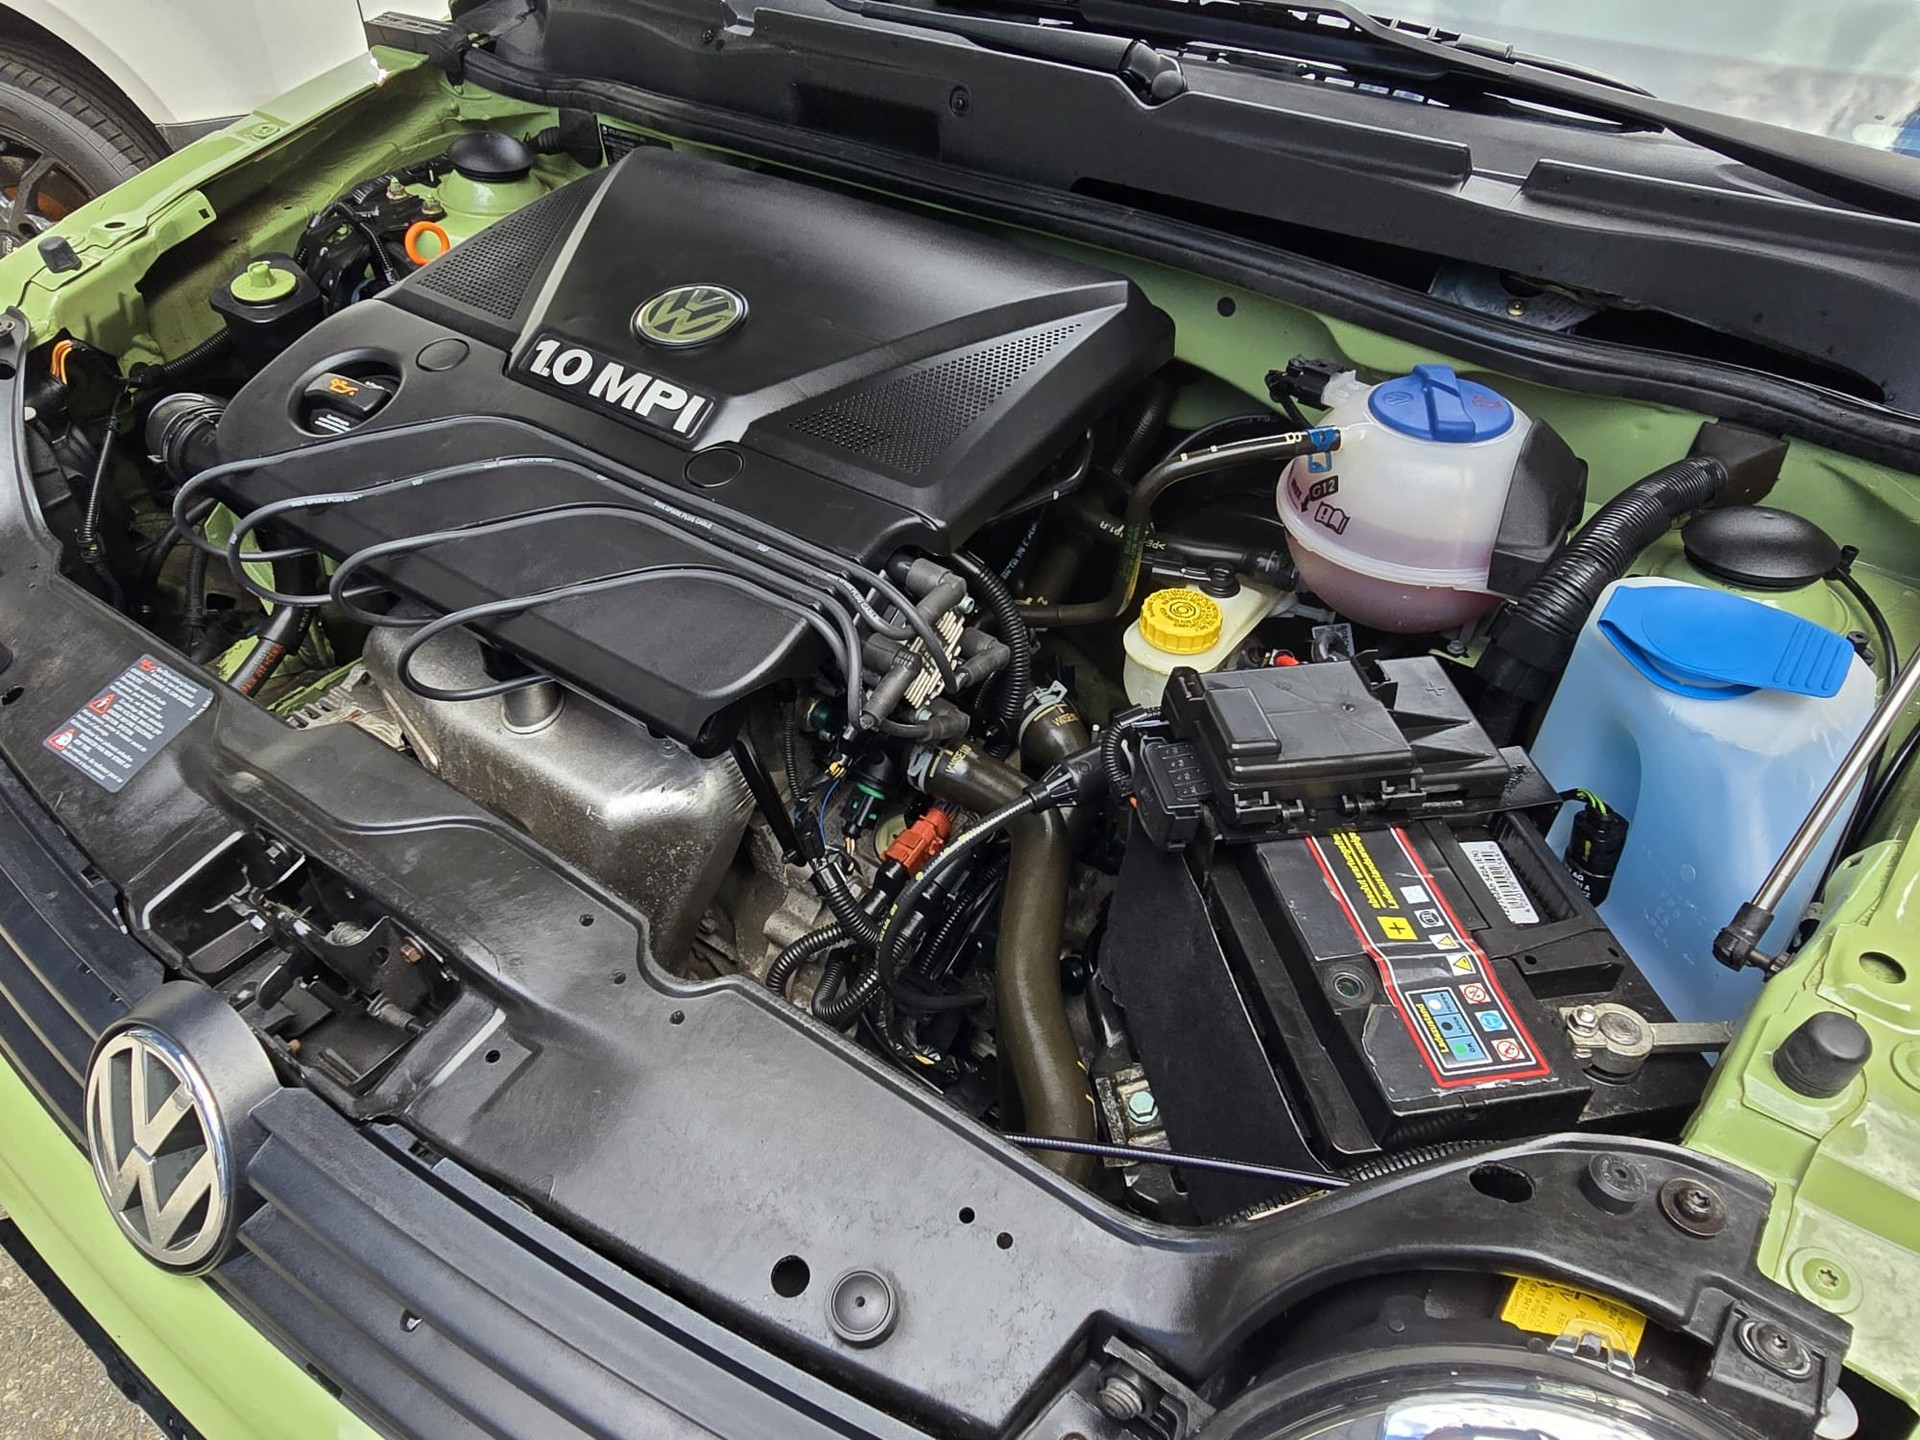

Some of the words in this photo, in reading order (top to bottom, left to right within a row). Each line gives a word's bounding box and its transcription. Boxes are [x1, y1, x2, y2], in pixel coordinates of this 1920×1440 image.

[530, 339, 593, 385] 1.0
[589, 362, 706, 434] MPI
[1312, 480, 1336, 498] G12
[1415, 1003, 1449, 1053] Ladezustand
[1466, 1042, 1476, 1053] OK
